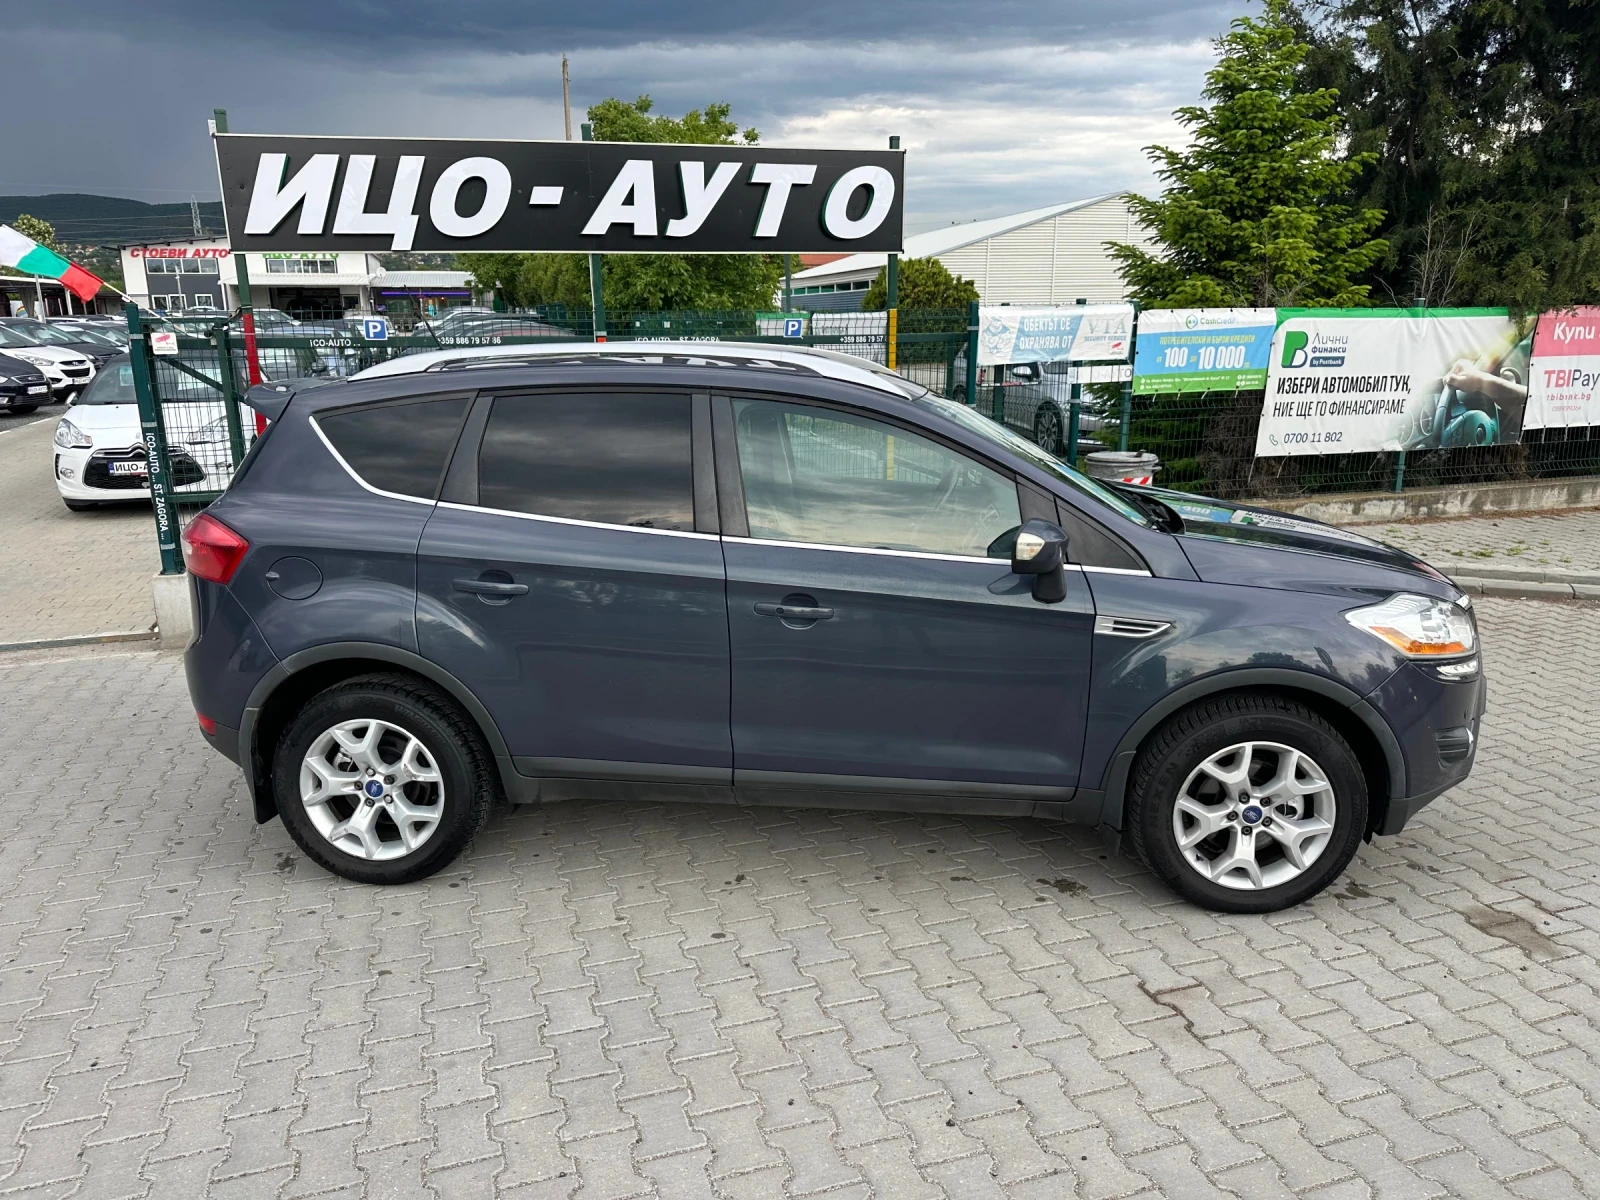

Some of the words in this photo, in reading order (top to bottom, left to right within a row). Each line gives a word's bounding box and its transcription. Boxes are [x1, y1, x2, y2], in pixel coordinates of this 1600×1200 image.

[130, 248, 187, 258] СТОЕВИ
[191, 248, 229, 258] АУТО
[1023, 318, 1058, 332] ОБЕКТЪТ
[1060, 317, 1071, 330] СЕ
[1087, 316, 1128, 334] VTA
[455, 336, 469, 345] 886
[470, 336, 480, 344] 79
[1019, 336, 1060, 350] ОХРАНЯВА
[1061, 335, 1073, 348] ОТ
[1311, 332, 1348, 345] Лични
[1164, 346, 1188, 367] 100
[1312, 358, 1319, 366] by
[1276, 376, 1320, 394] ИЗБЕРИ
[1320, 375, 1387, 394] АВТОМОБИЛ
[1388, 375, 1411, 394] ТУК,
[1543, 368, 1600, 391] TBIPay
[1272, 401, 1295, 418] НИЕ
[1296, 401, 1313, 420] ЩЕ
[1314, 400, 1327, 417] ГО
[1328, 398, 1406, 416] ФИНАНСИРАМЕ
[1283, 432, 1308, 444] 0700
[1310, 432, 1321, 443] 11
[1323, 431, 1343, 443] 802
[155, 497, 169, 532] ZAGORA
